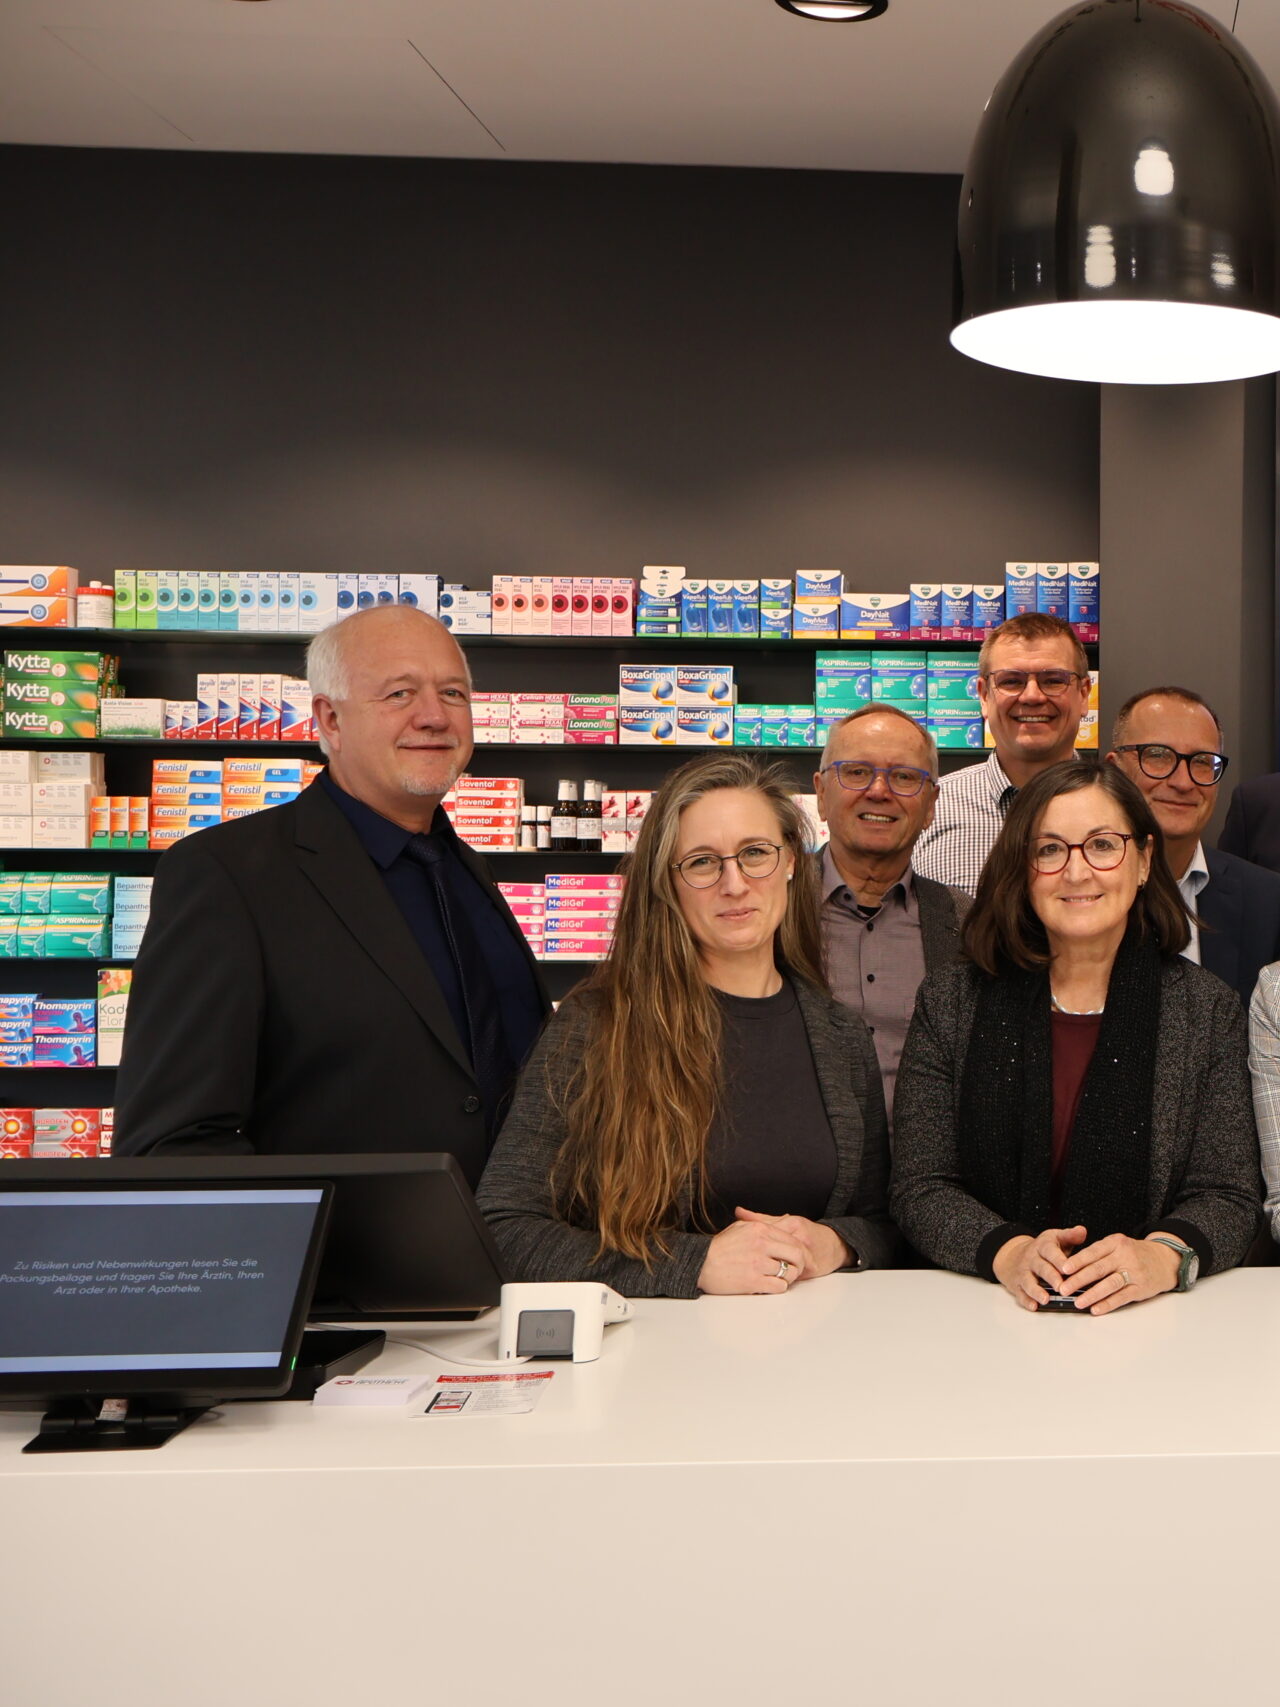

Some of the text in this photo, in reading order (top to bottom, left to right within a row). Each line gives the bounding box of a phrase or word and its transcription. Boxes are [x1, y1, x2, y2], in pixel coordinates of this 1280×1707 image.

[861, 610, 889, 619] DayNait
[7, 654, 51, 672] Kytta
[622, 670, 674, 680] BoxaGrippal
[678, 671, 729, 680] BoxaGrippal
[7, 683, 50, 701] Kytta
[571, 696, 615, 704] LoranoPro
[622, 710, 673, 719] BoxaGrippal
[678, 711, 729, 720] BoxaGrippal
[5, 712, 48, 729] Kytta
[570, 720, 614, 729] LoranoPro
[157, 763, 187, 771] Fenistil
[229, 762, 261, 771] Fenistil
[156, 785, 186, 794] Fenistil
[228, 785, 261, 794] Fenistil
[156, 808, 186, 816] Fenistil
[548, 878, 585, 886] MediGel
[548, 899, 585, 907] MediGel
[547, 920, 583, 928] MediGel
[547, 941, 584, 949] MediGel
[34, 1002, 92, 1010] Thomapyrin
[100, 1004, 127, 1014] Kad
[35, 1036, 92, 1044] Thomapyrin
[14, 1258, 257, 1271] Zu Risiken und Nebenwirkungen lesen Sie die
[0, 1268, 264, 1284] Packungsbeilage und fragen Sie Ihre Ärztin, Ihren
[53, 1284, 202, 1295] Arzt oder in Ihrer Apotheke.
